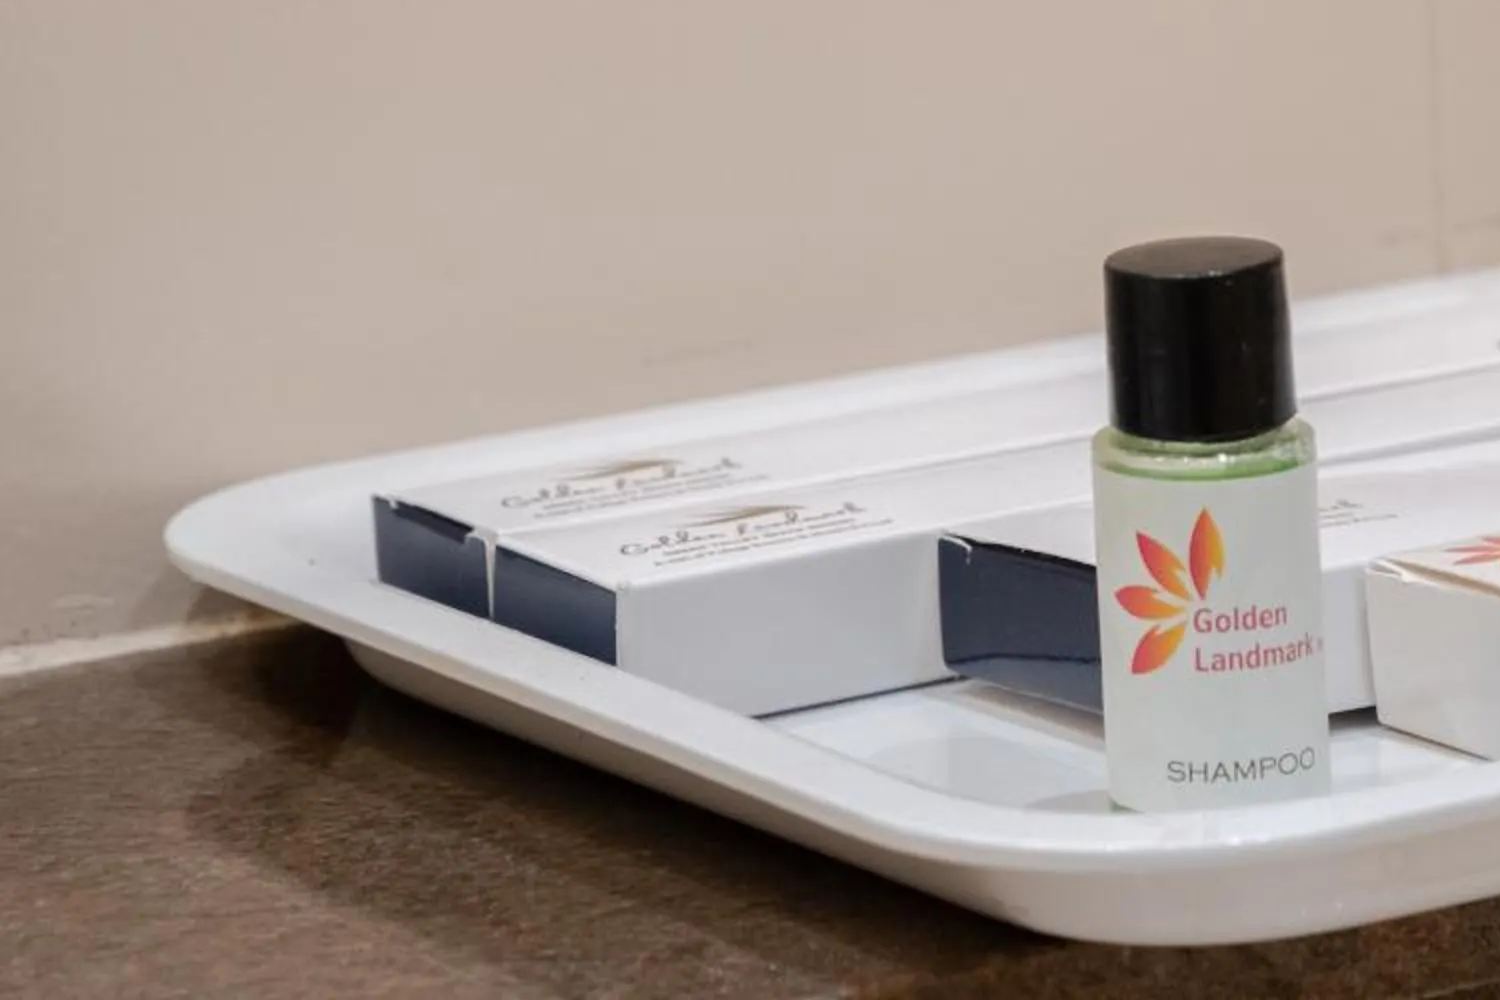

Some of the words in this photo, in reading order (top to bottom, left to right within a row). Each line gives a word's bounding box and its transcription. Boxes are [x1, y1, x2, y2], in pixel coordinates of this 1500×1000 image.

[1193, 604, 1288, 633] Golden
[1195, 632, 1313, 672] Landmark
[1167, 746, 1317, 784] SHAMPOO
